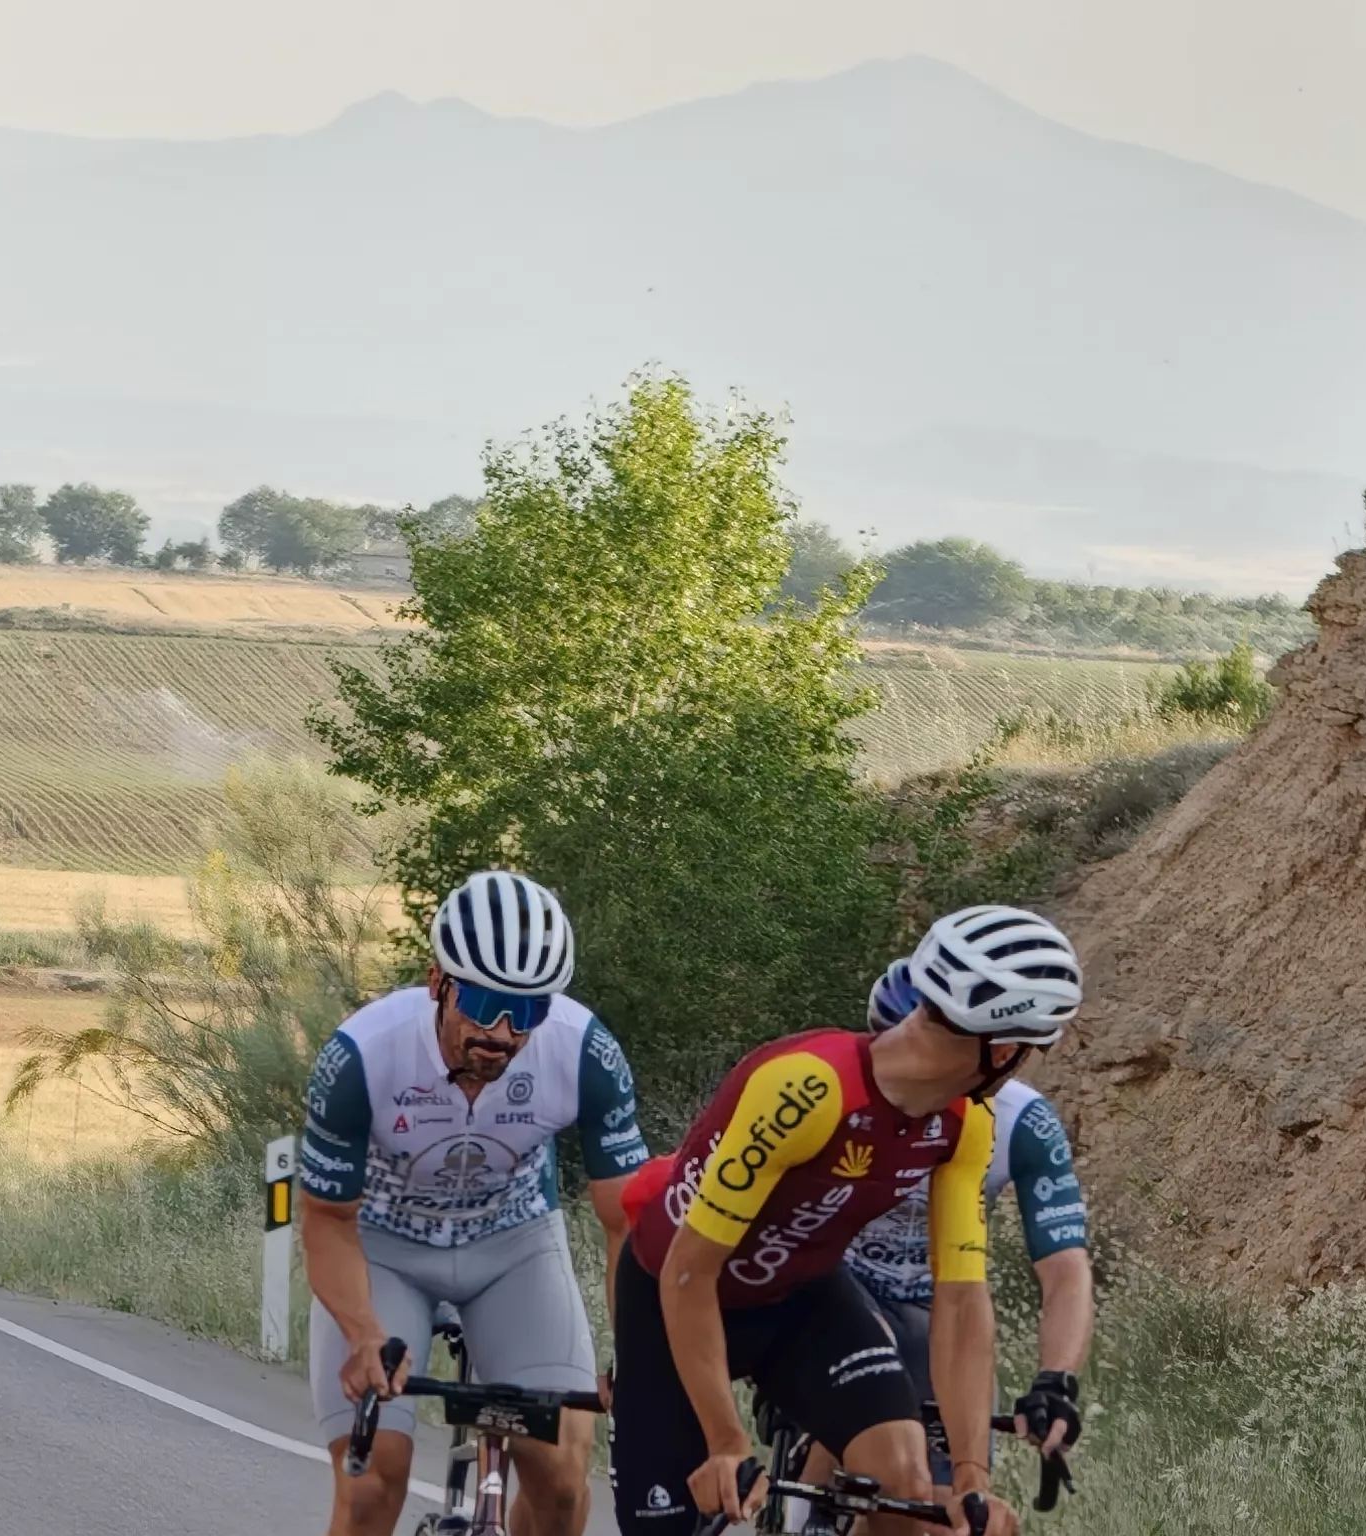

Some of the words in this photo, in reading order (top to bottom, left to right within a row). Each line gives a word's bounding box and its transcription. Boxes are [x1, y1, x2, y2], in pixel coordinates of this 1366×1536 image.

[990, 998, 1036, 1020] uvex
[276, 1154, 288, 1169] 6
[717, 1074, 829, 1192] Cofidis
[727, 1184, 854, 1286] Cofidis
